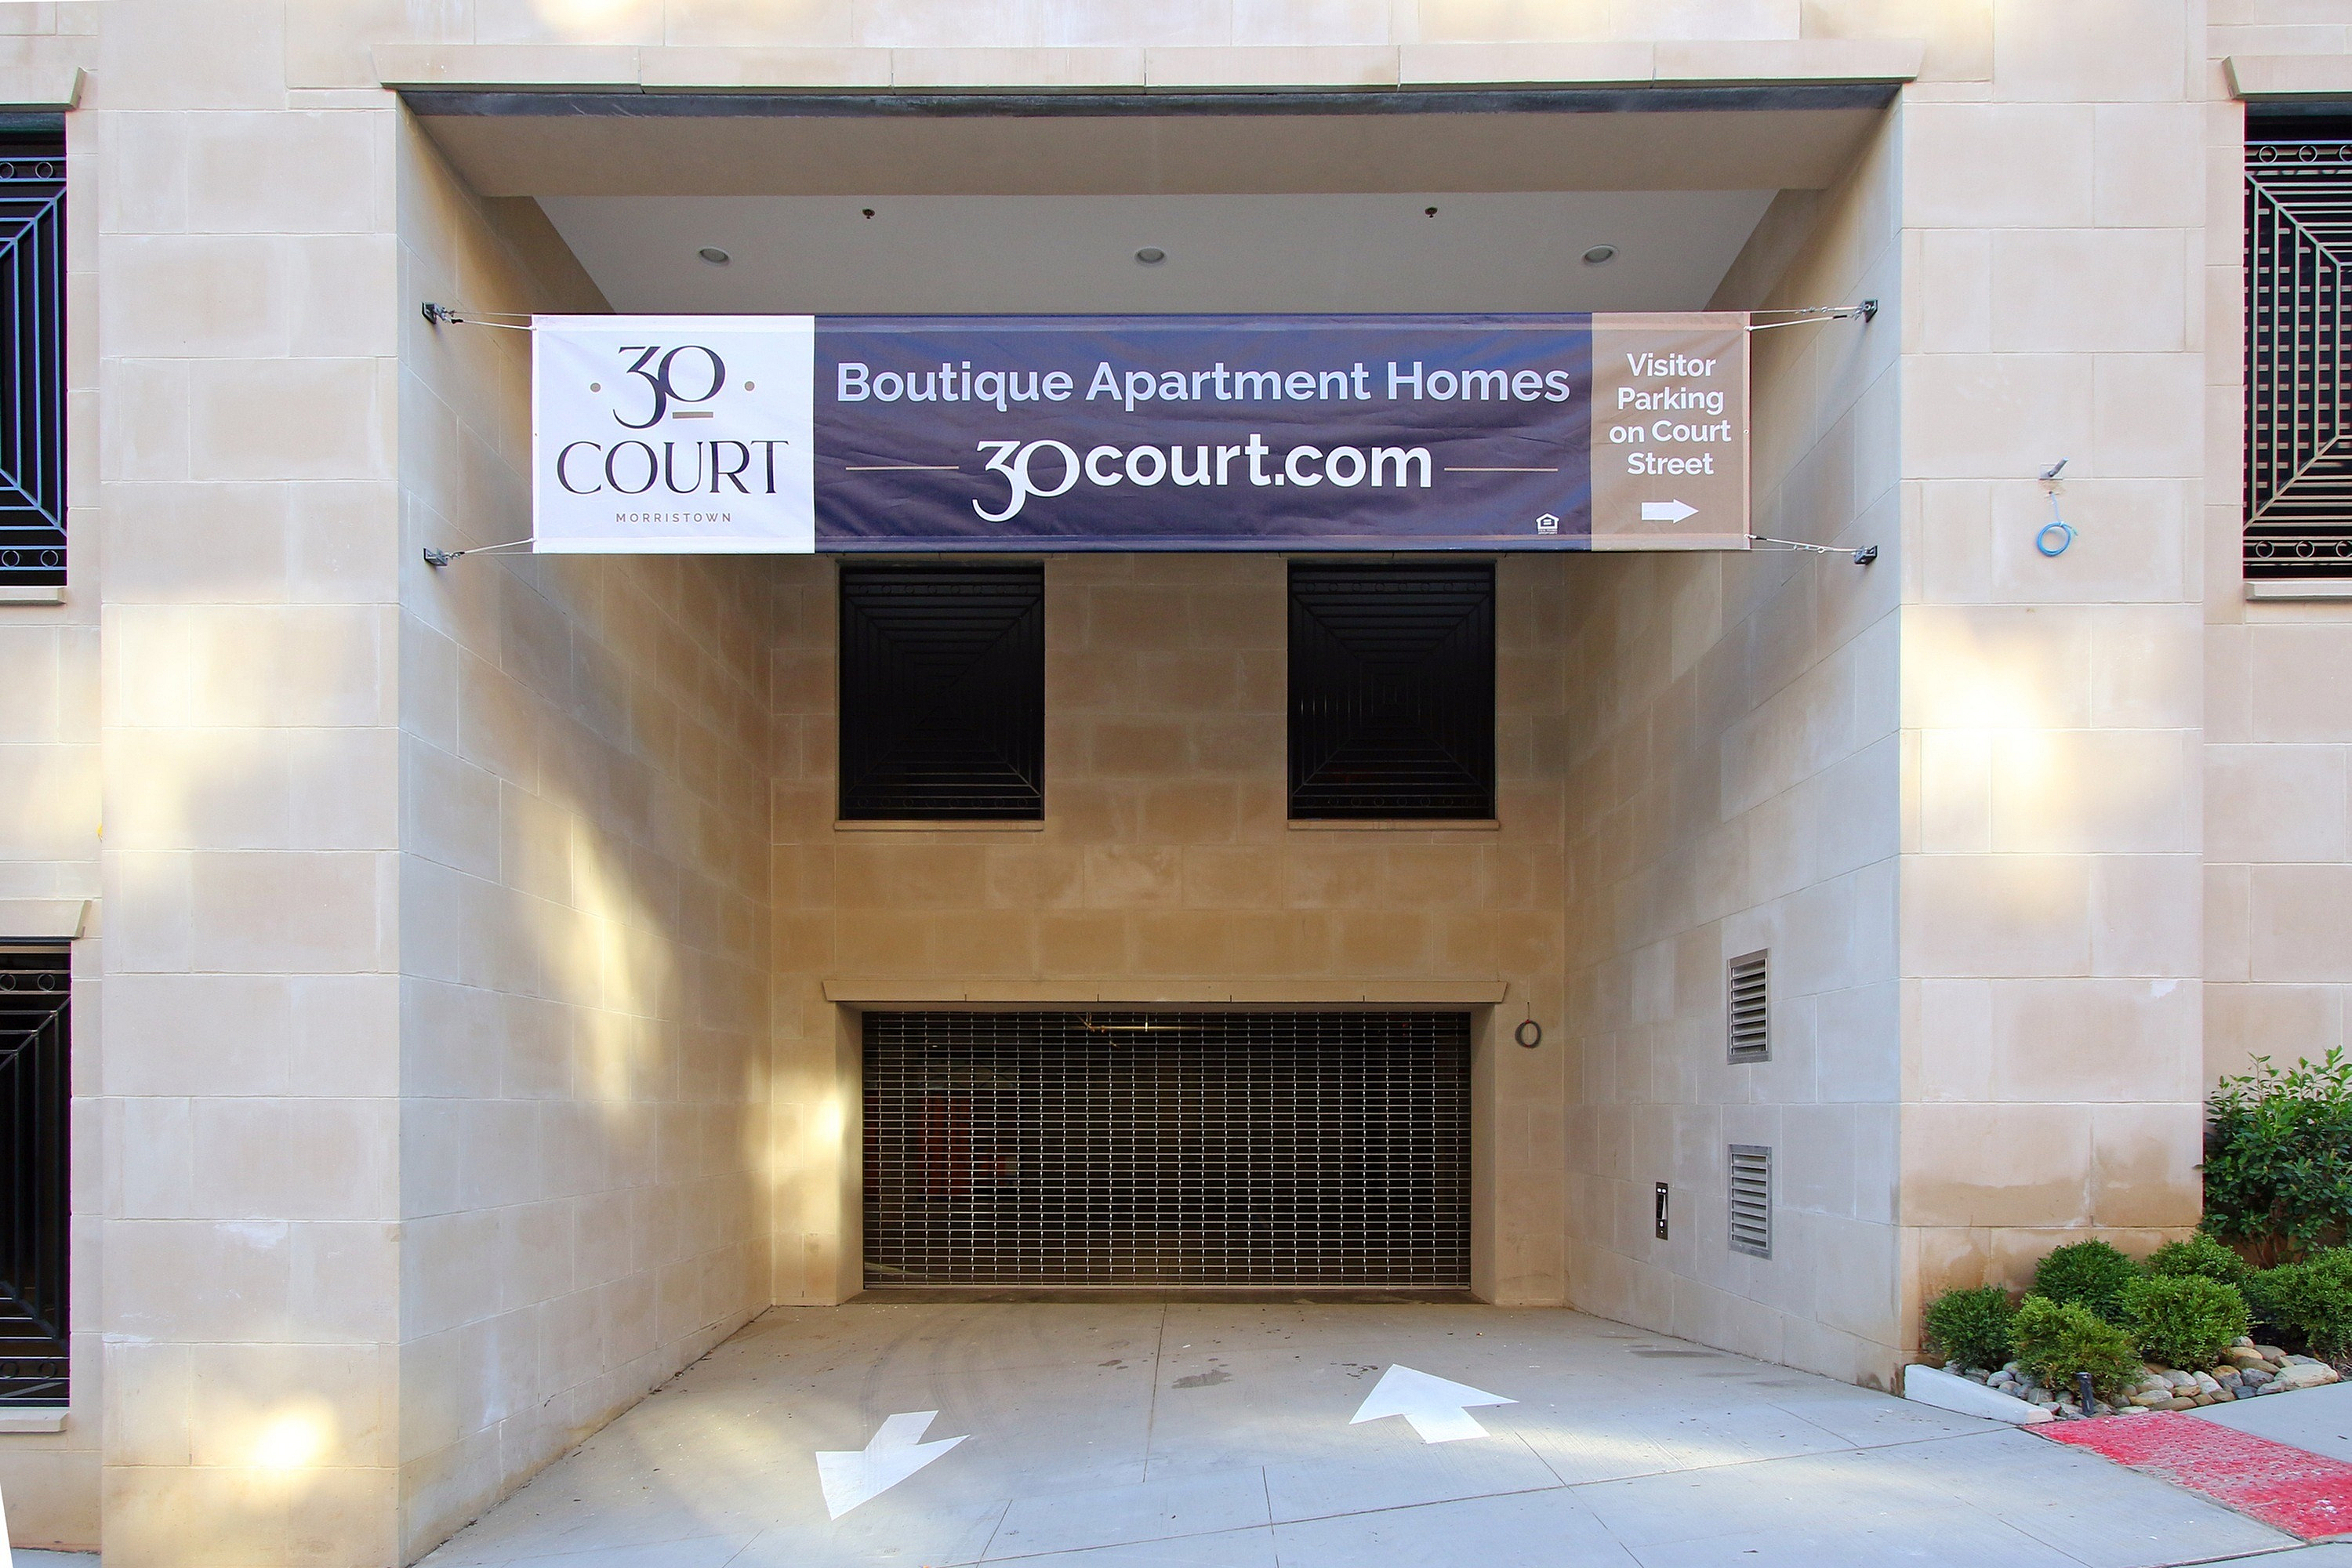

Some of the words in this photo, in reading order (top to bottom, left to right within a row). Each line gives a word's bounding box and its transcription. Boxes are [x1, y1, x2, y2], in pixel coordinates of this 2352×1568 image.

[1626, 352, 1716, 377] Visitor
[612, 345, 726, 430] 30
[837, 361, 1073, 412] Boutique
[1085, 361, 1371, 412] Apartment
[1388, 361, 1570, 402] Homes
[1618, 387, 1724, 416] Parking
[1609, 426, 1645, 444] on
[1651, 419, 1732, 442] Court
[557, 440, 789, 495] COURT
[972, 434, 1432, 522] 30court.com
[1627, 452, 1715, 475] Street
[616, 513, 731, 523] MORRISTOWN
